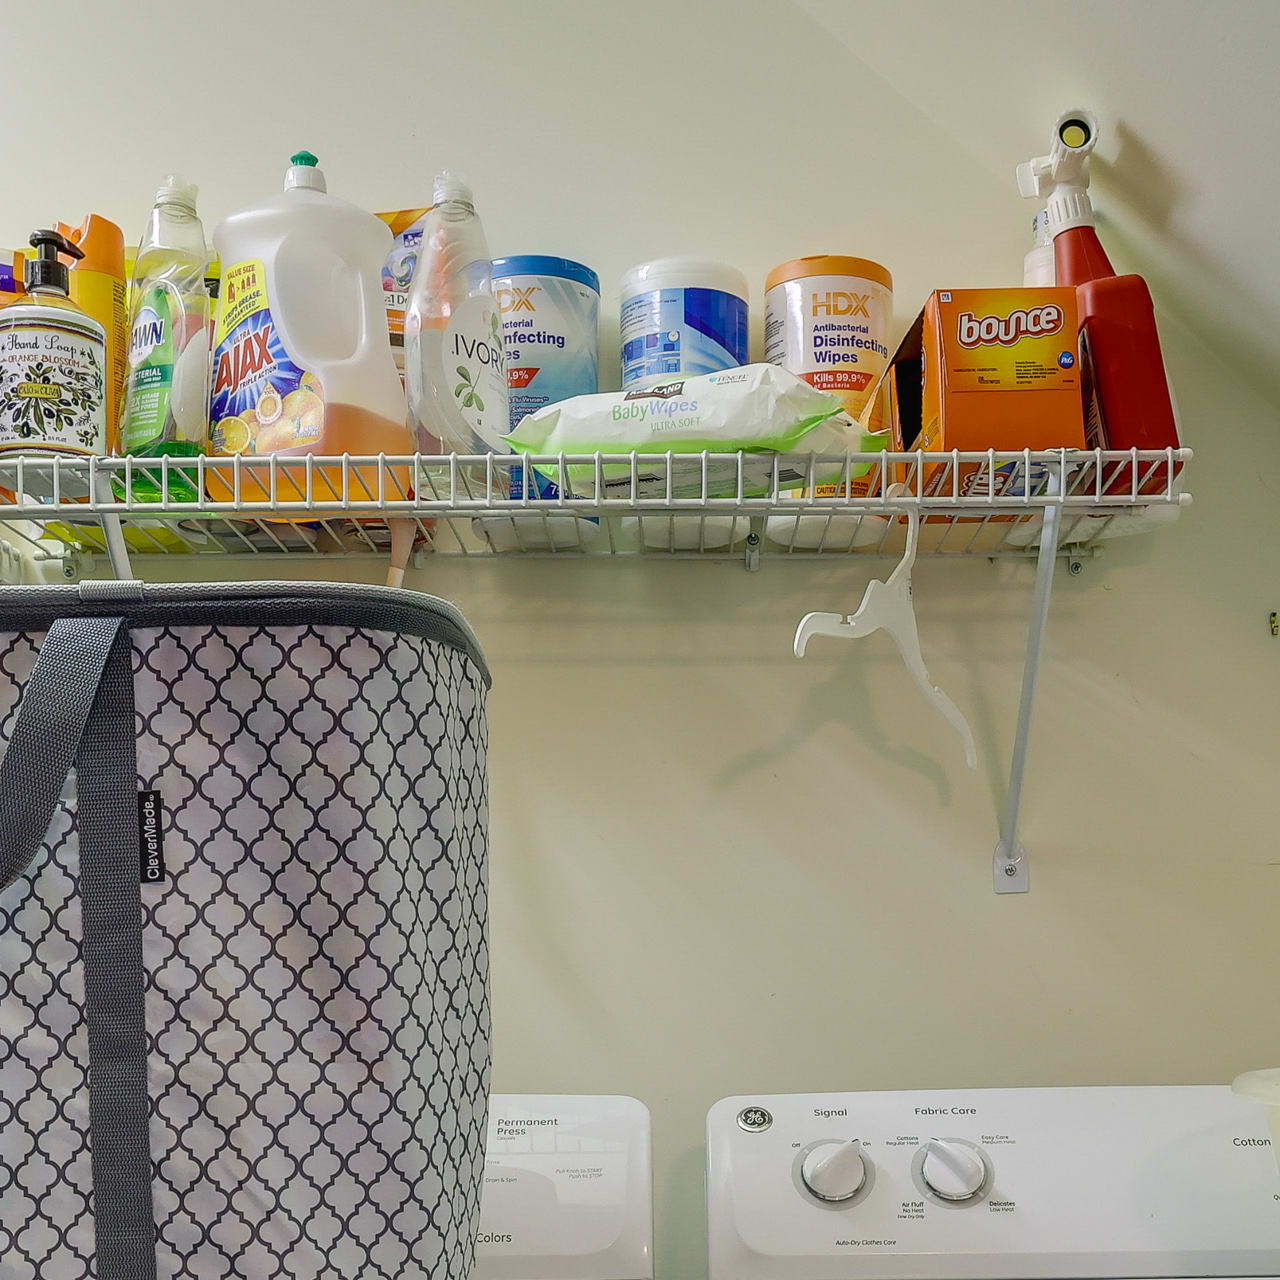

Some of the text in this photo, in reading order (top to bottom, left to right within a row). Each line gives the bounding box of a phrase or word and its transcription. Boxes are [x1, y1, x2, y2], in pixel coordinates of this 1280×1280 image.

[227, 263, 256, 280] VALUE SIZE
[812, 291, 871, 319] HDX
[222, 304, 238, 324] STRIPS
[813, 323, 869, 334] Antibacterial
[960, 304, 1058, 344] bounce
[130, 320, 163, 353] AWN
[233, 328, 251, 345] ULTRA
[504, 331, 566, 349] nfecting
[7, 333, 77, 359] Hand Soap
[813, 335, 889, 359] Disinfecting
[8, 354, 80, 368] ORANGE BLOSSOM
[214, 325, 274, 396] AJAX
[506, 349, 521, 361] es
[814, 350, 859, 365] Wipes
[239, 365, 278, 390] TRIPLE ACTION
[813, 373, 866, 384] Kills 99.9%
[650, 417, 701, 432] ULTRA SOFT
[813, 1108, 848, 1118] Signal
[914, 1106, 977, 1115] Fabric Care
[497, 1118, 559, 1127] Permanent
[497, 1127, 526, 1136] Press
[476, 1232, 513, 1243] Colors
